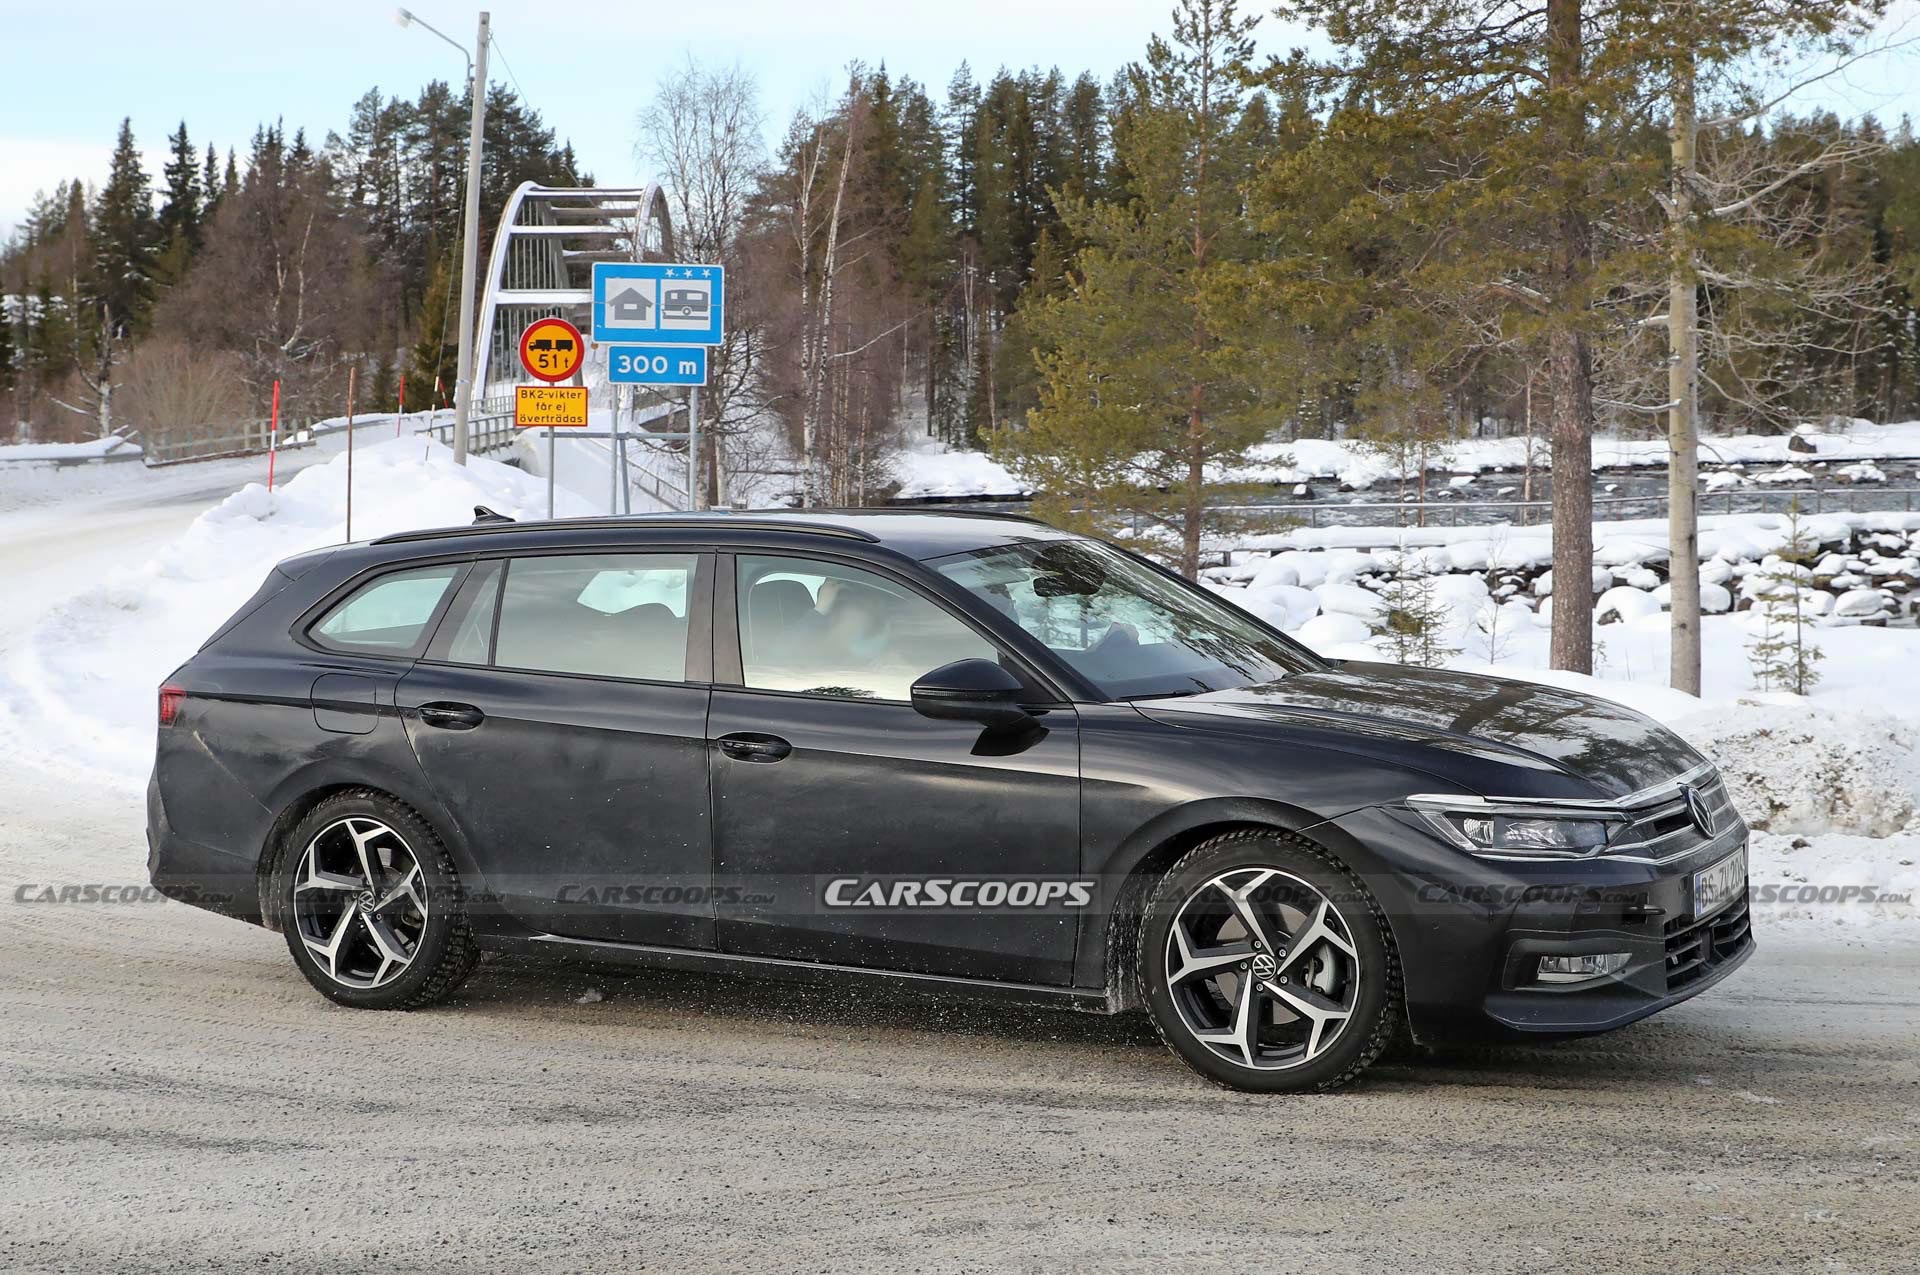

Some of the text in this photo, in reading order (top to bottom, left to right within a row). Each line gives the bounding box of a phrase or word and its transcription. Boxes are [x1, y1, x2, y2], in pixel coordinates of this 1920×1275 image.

[538, 354, 569, 369] 51 t
[617, 355, 697, 375] 300 m
[521, 389, 583, 400] BK2-vikter
[536, 401, 566, 413] får ej
[519, 413, 584, 424] överträdas
